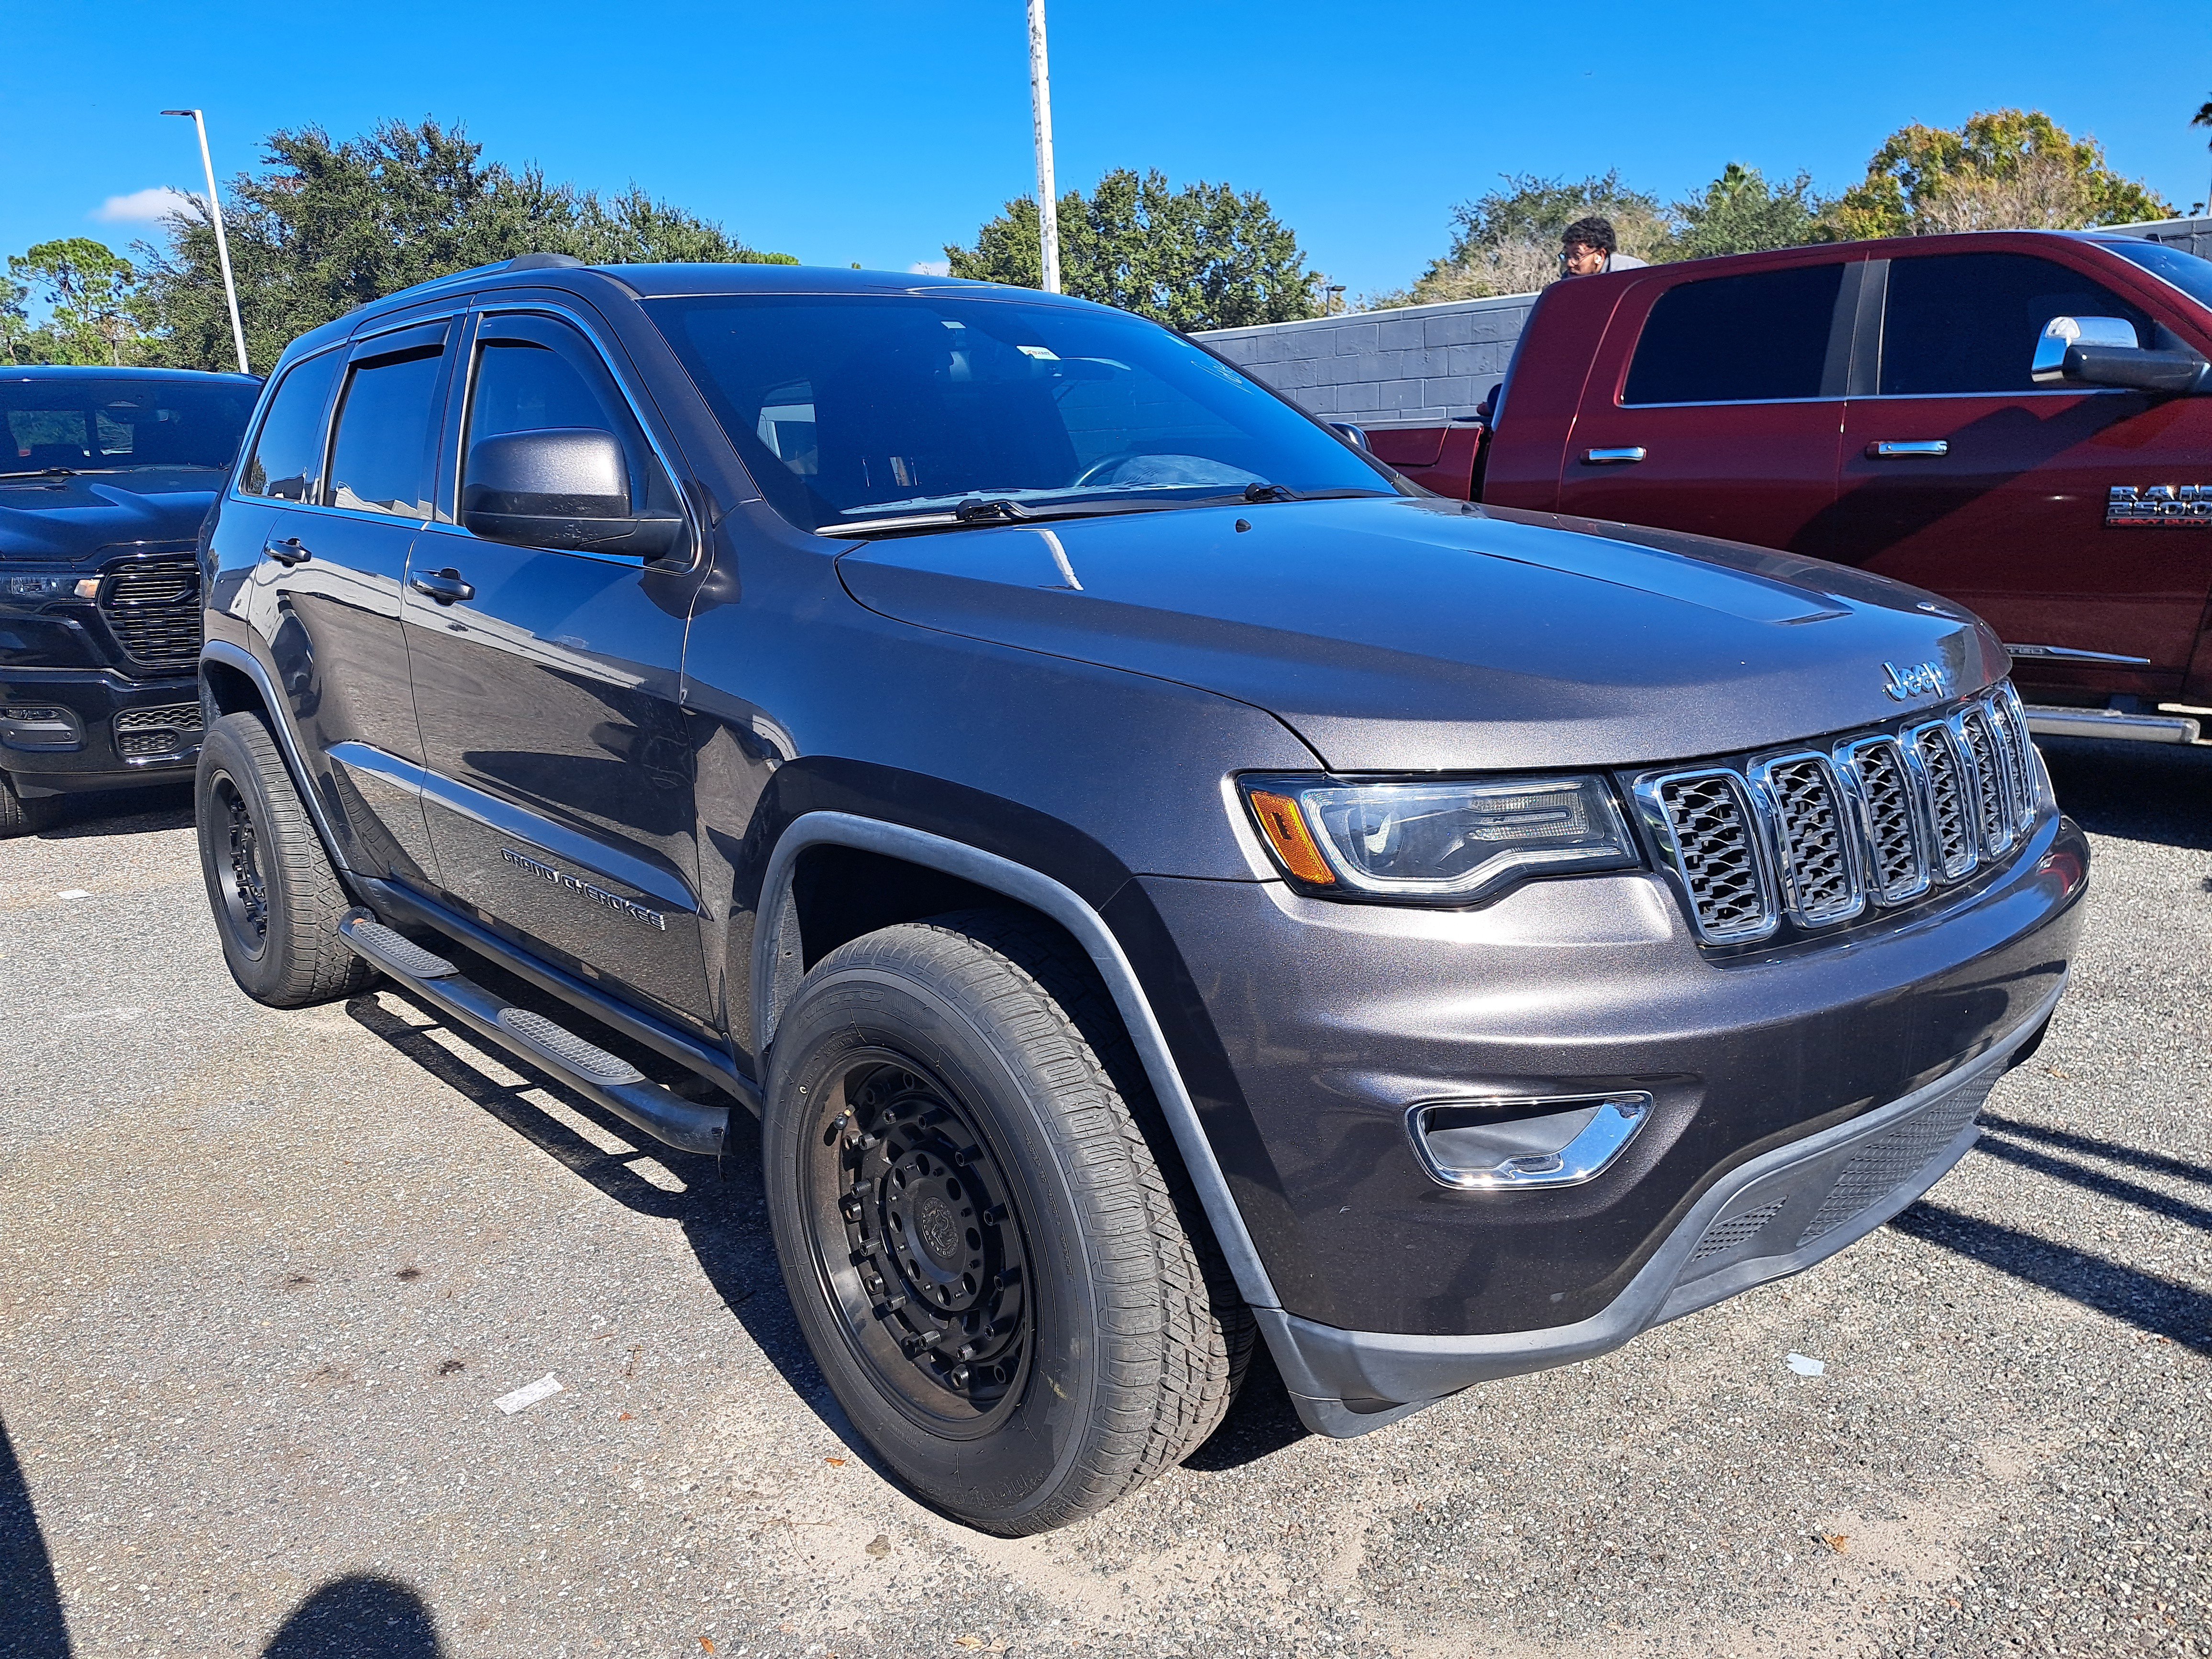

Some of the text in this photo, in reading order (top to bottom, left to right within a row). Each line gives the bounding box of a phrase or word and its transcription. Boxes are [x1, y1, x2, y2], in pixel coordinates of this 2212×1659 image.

[2110, 485, 2212, 501] RAM
[2108, 501, 2212, 517] 2500
[1881, 661, 1947, 703] Jeep
[500, 848, 665, 931] GRAND CHEROKEE
